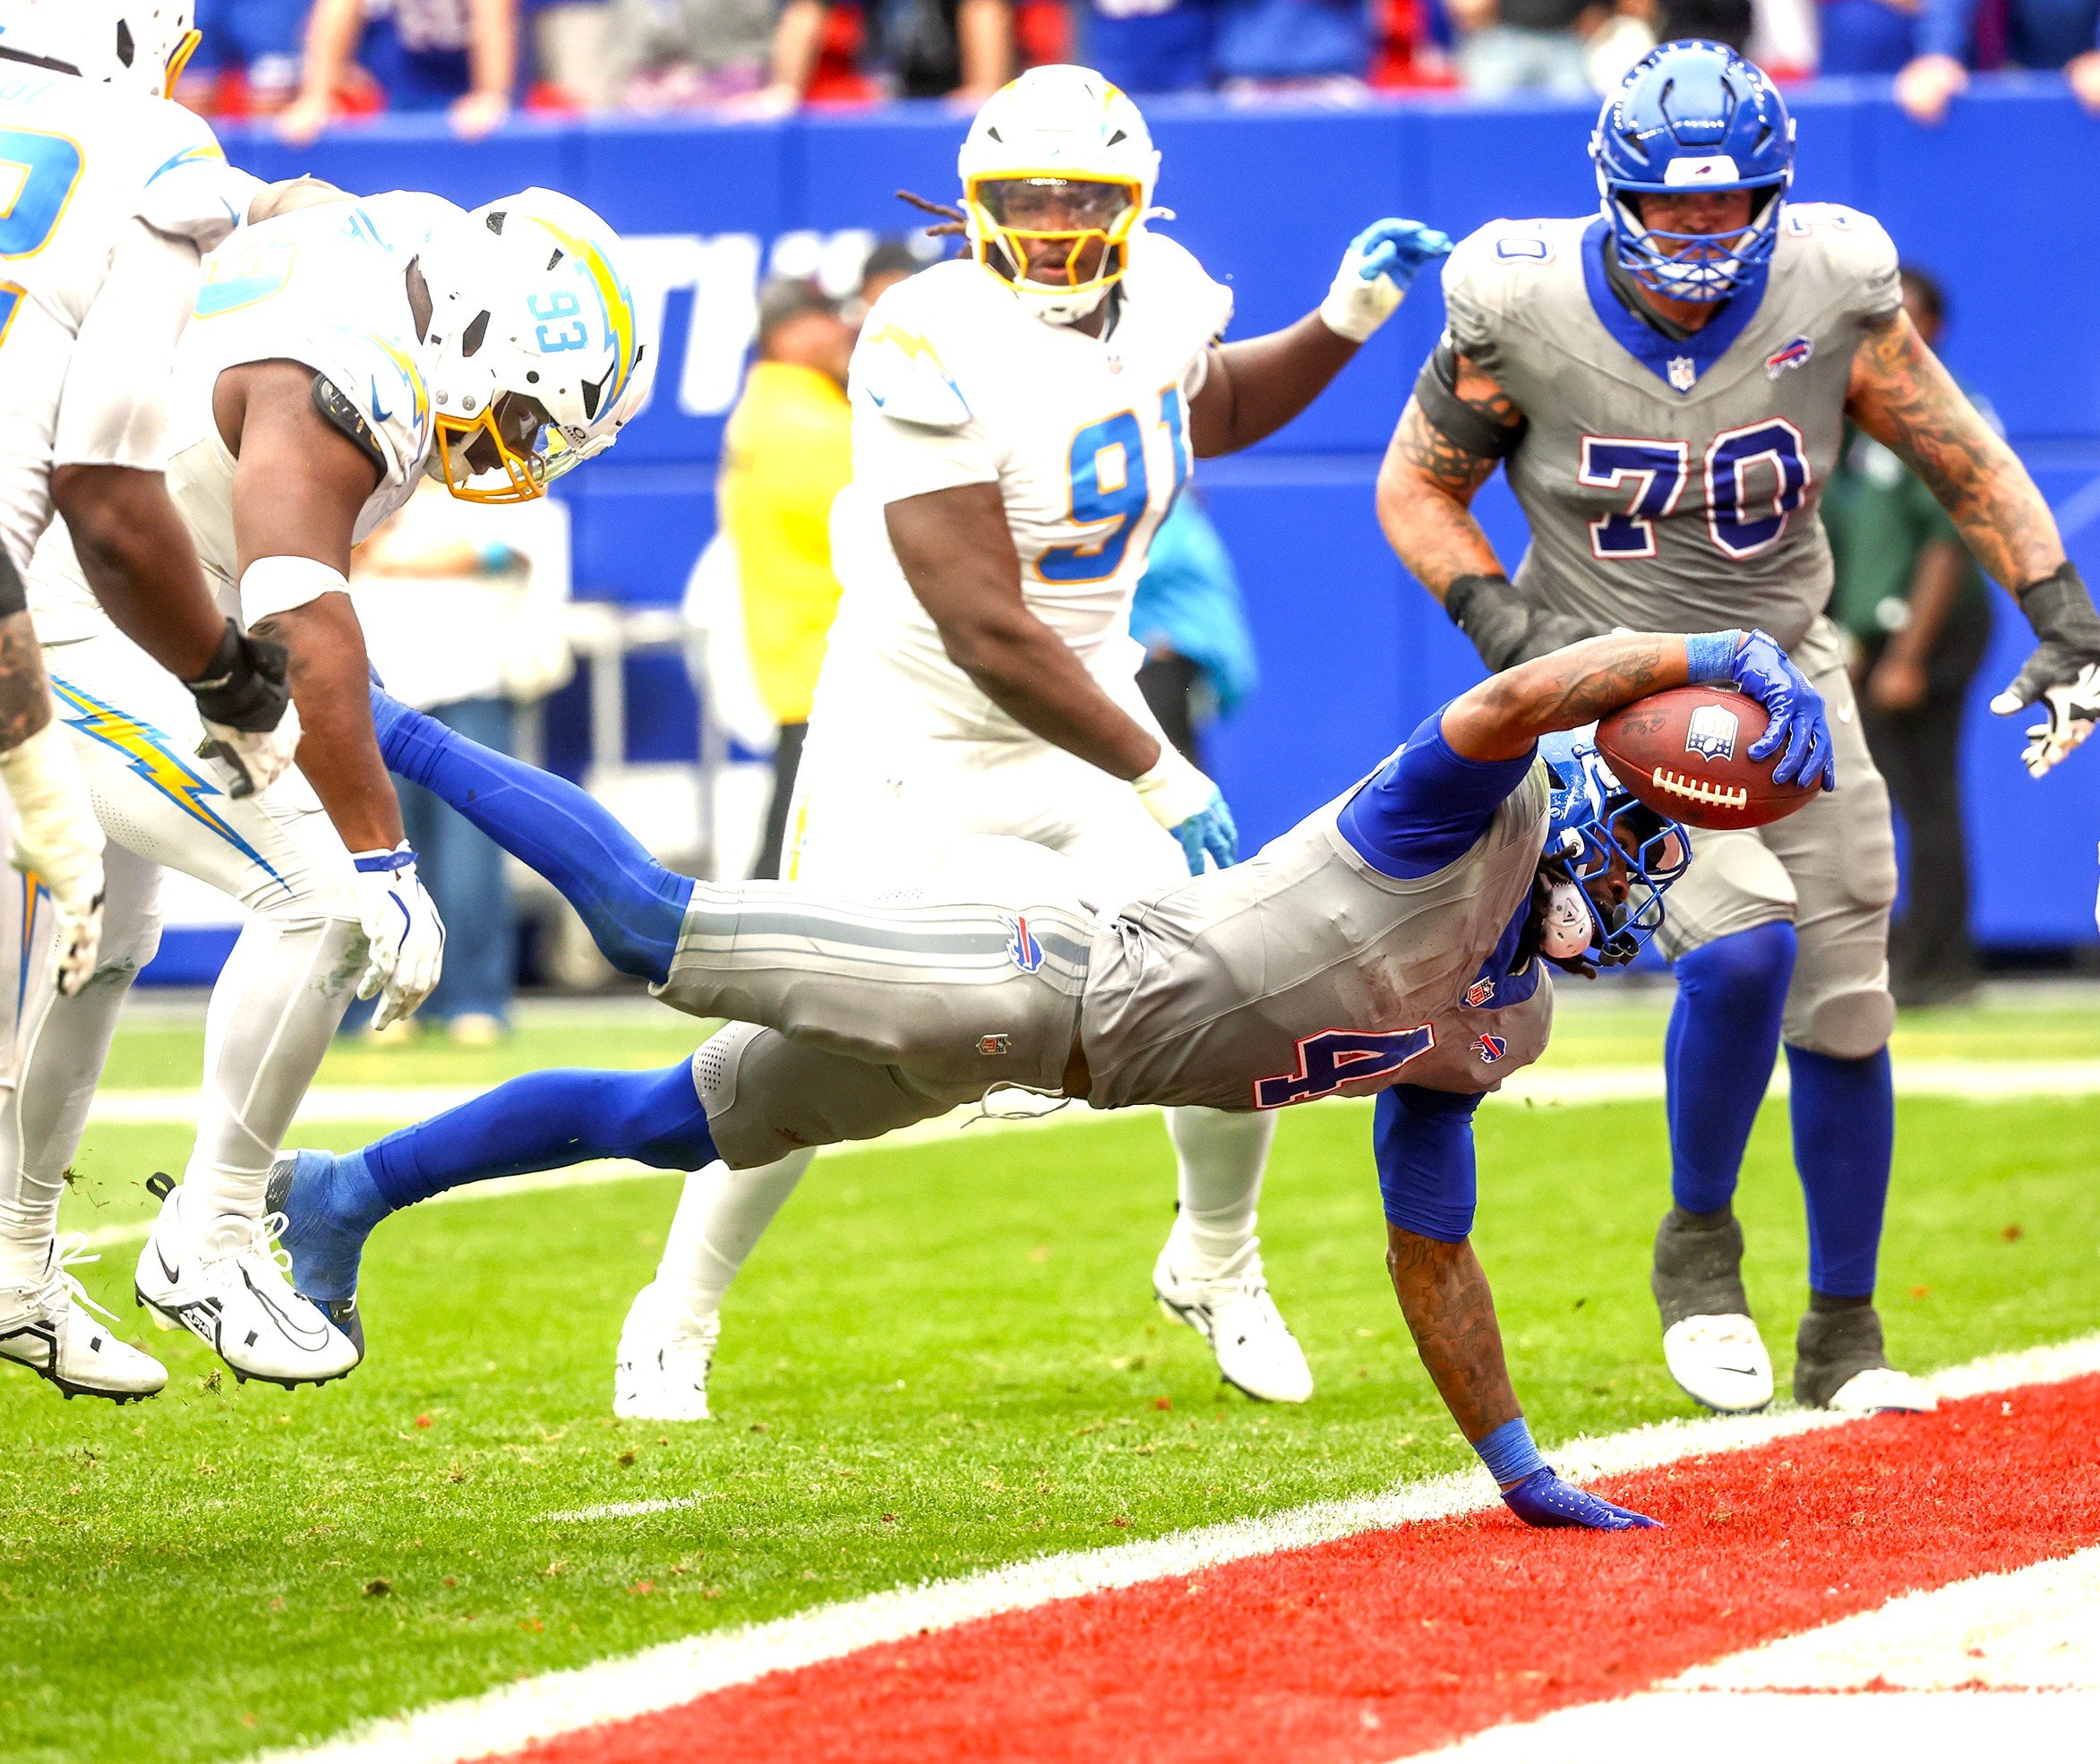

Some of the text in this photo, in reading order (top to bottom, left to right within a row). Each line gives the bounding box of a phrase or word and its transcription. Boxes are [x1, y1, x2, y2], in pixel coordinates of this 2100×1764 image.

[527, 291, 587, 353] 93
[1034, 380, 1187, 586] 91
[1578, 416, 1811, 560] 70
[1254, 1023, 1435, 1109] 4
[182, 1308, 212, 1340] ALPHA
